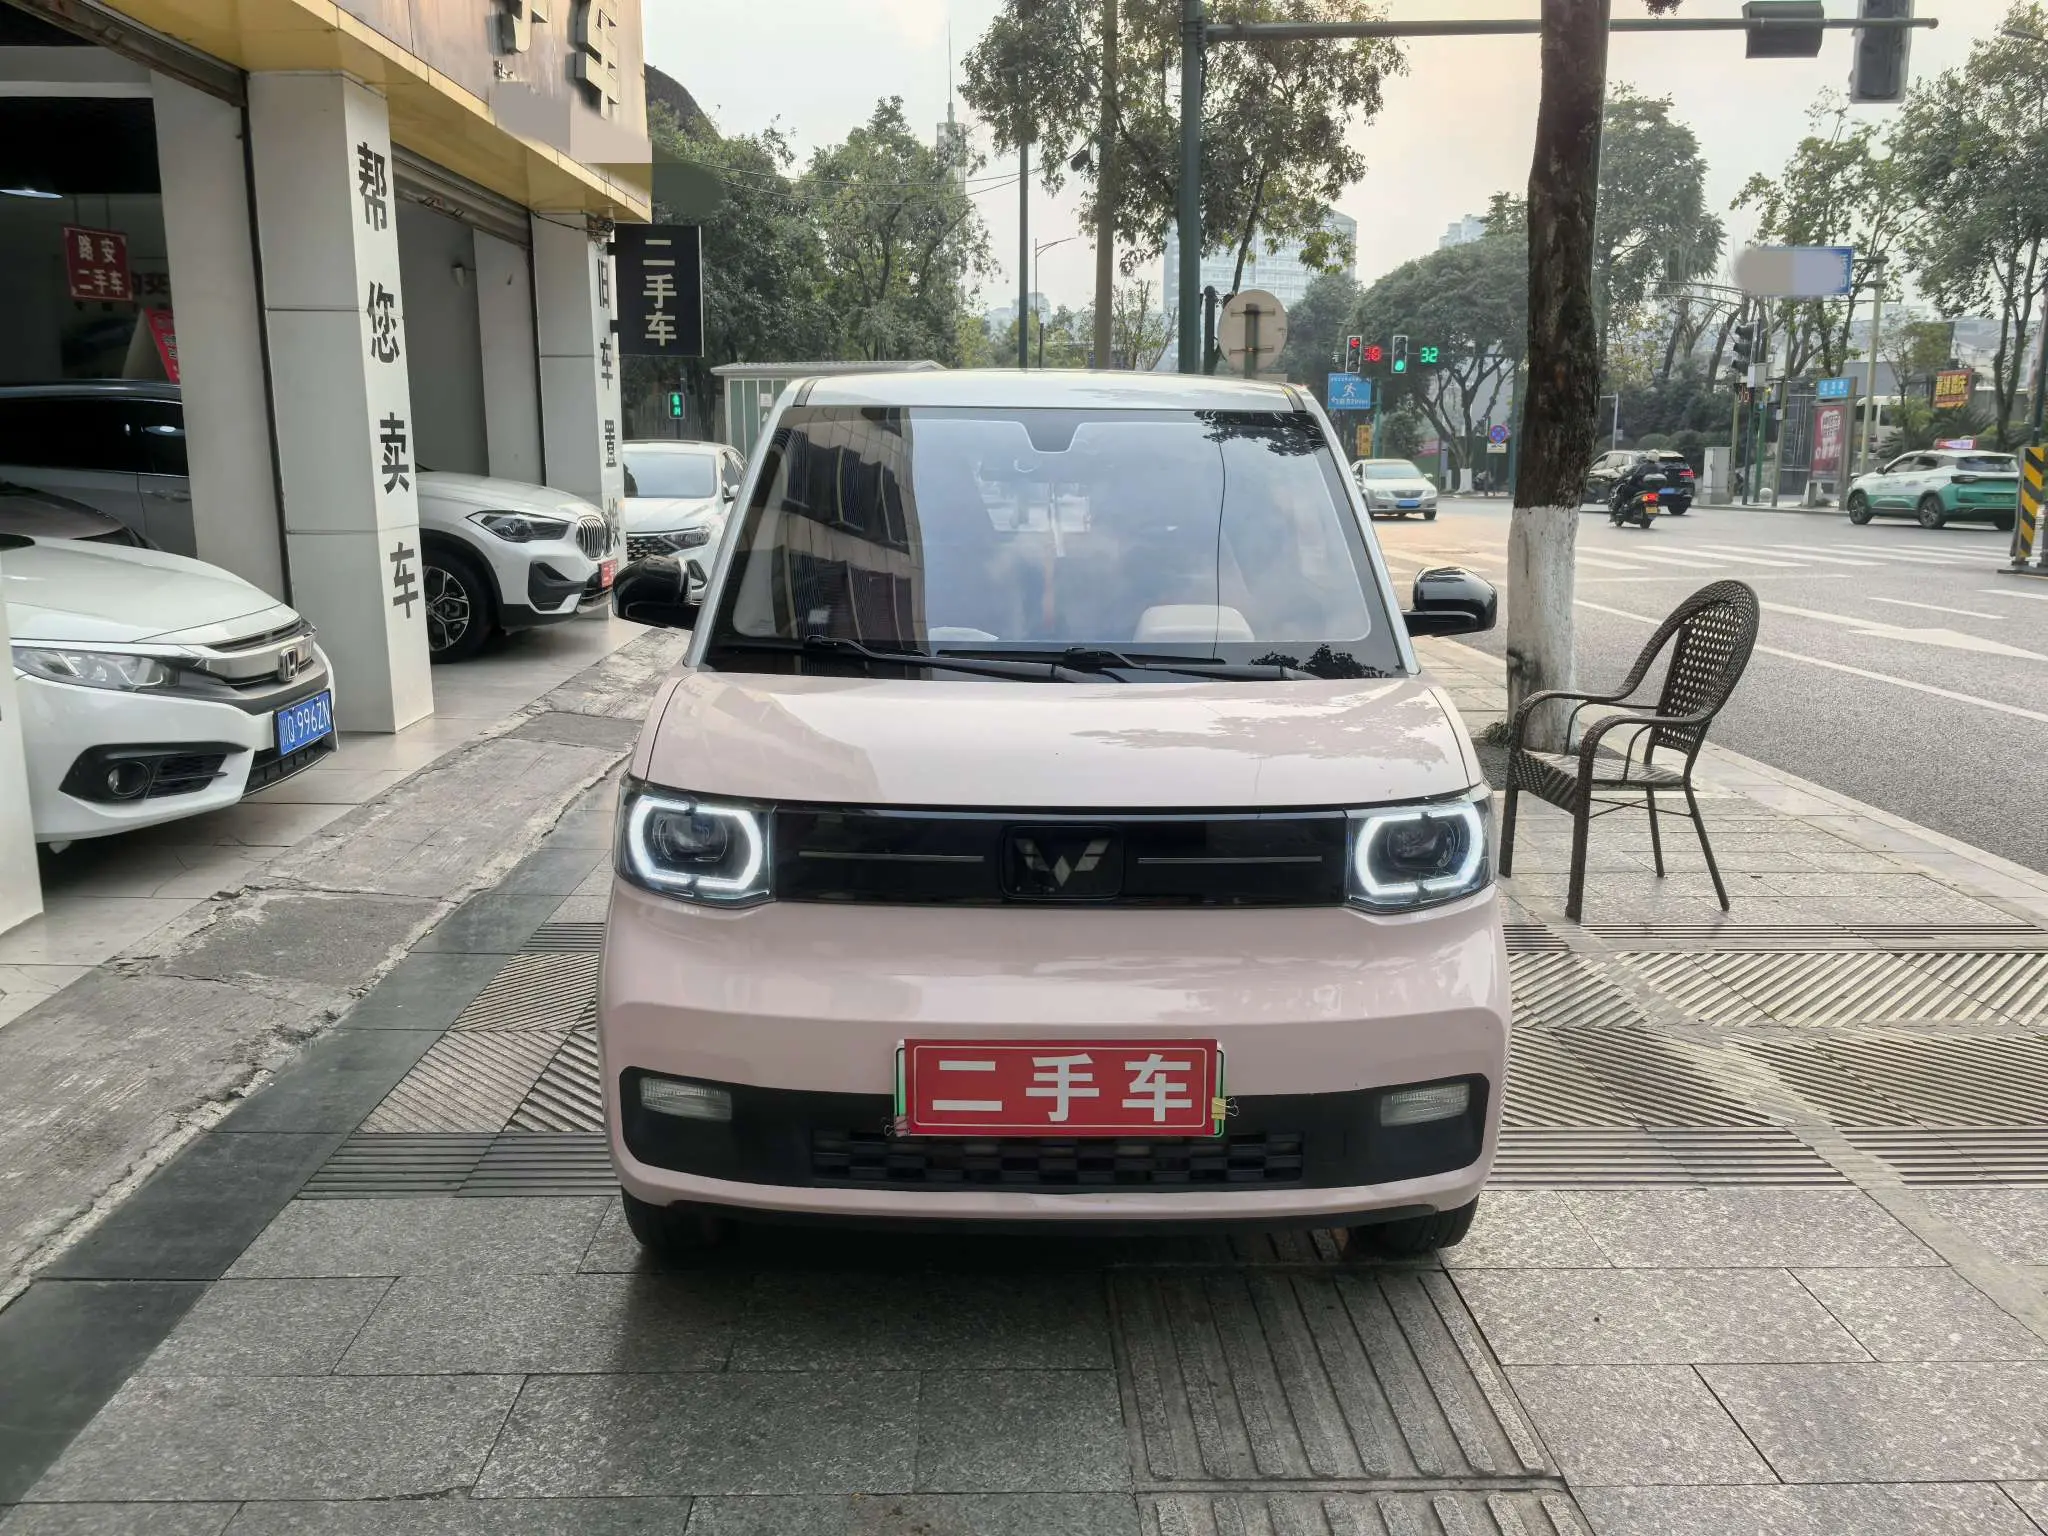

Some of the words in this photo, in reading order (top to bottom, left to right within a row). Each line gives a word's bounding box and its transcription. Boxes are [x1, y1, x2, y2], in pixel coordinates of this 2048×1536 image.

[78, 269, 124, 295] 二手车
[642, 239, 677, 346] 二手车
[357, 142, 420, 619] 帮您卖车
[1421, 347, 1439, 363] 32
[932, 1053, 1193, 1122] 二手车
